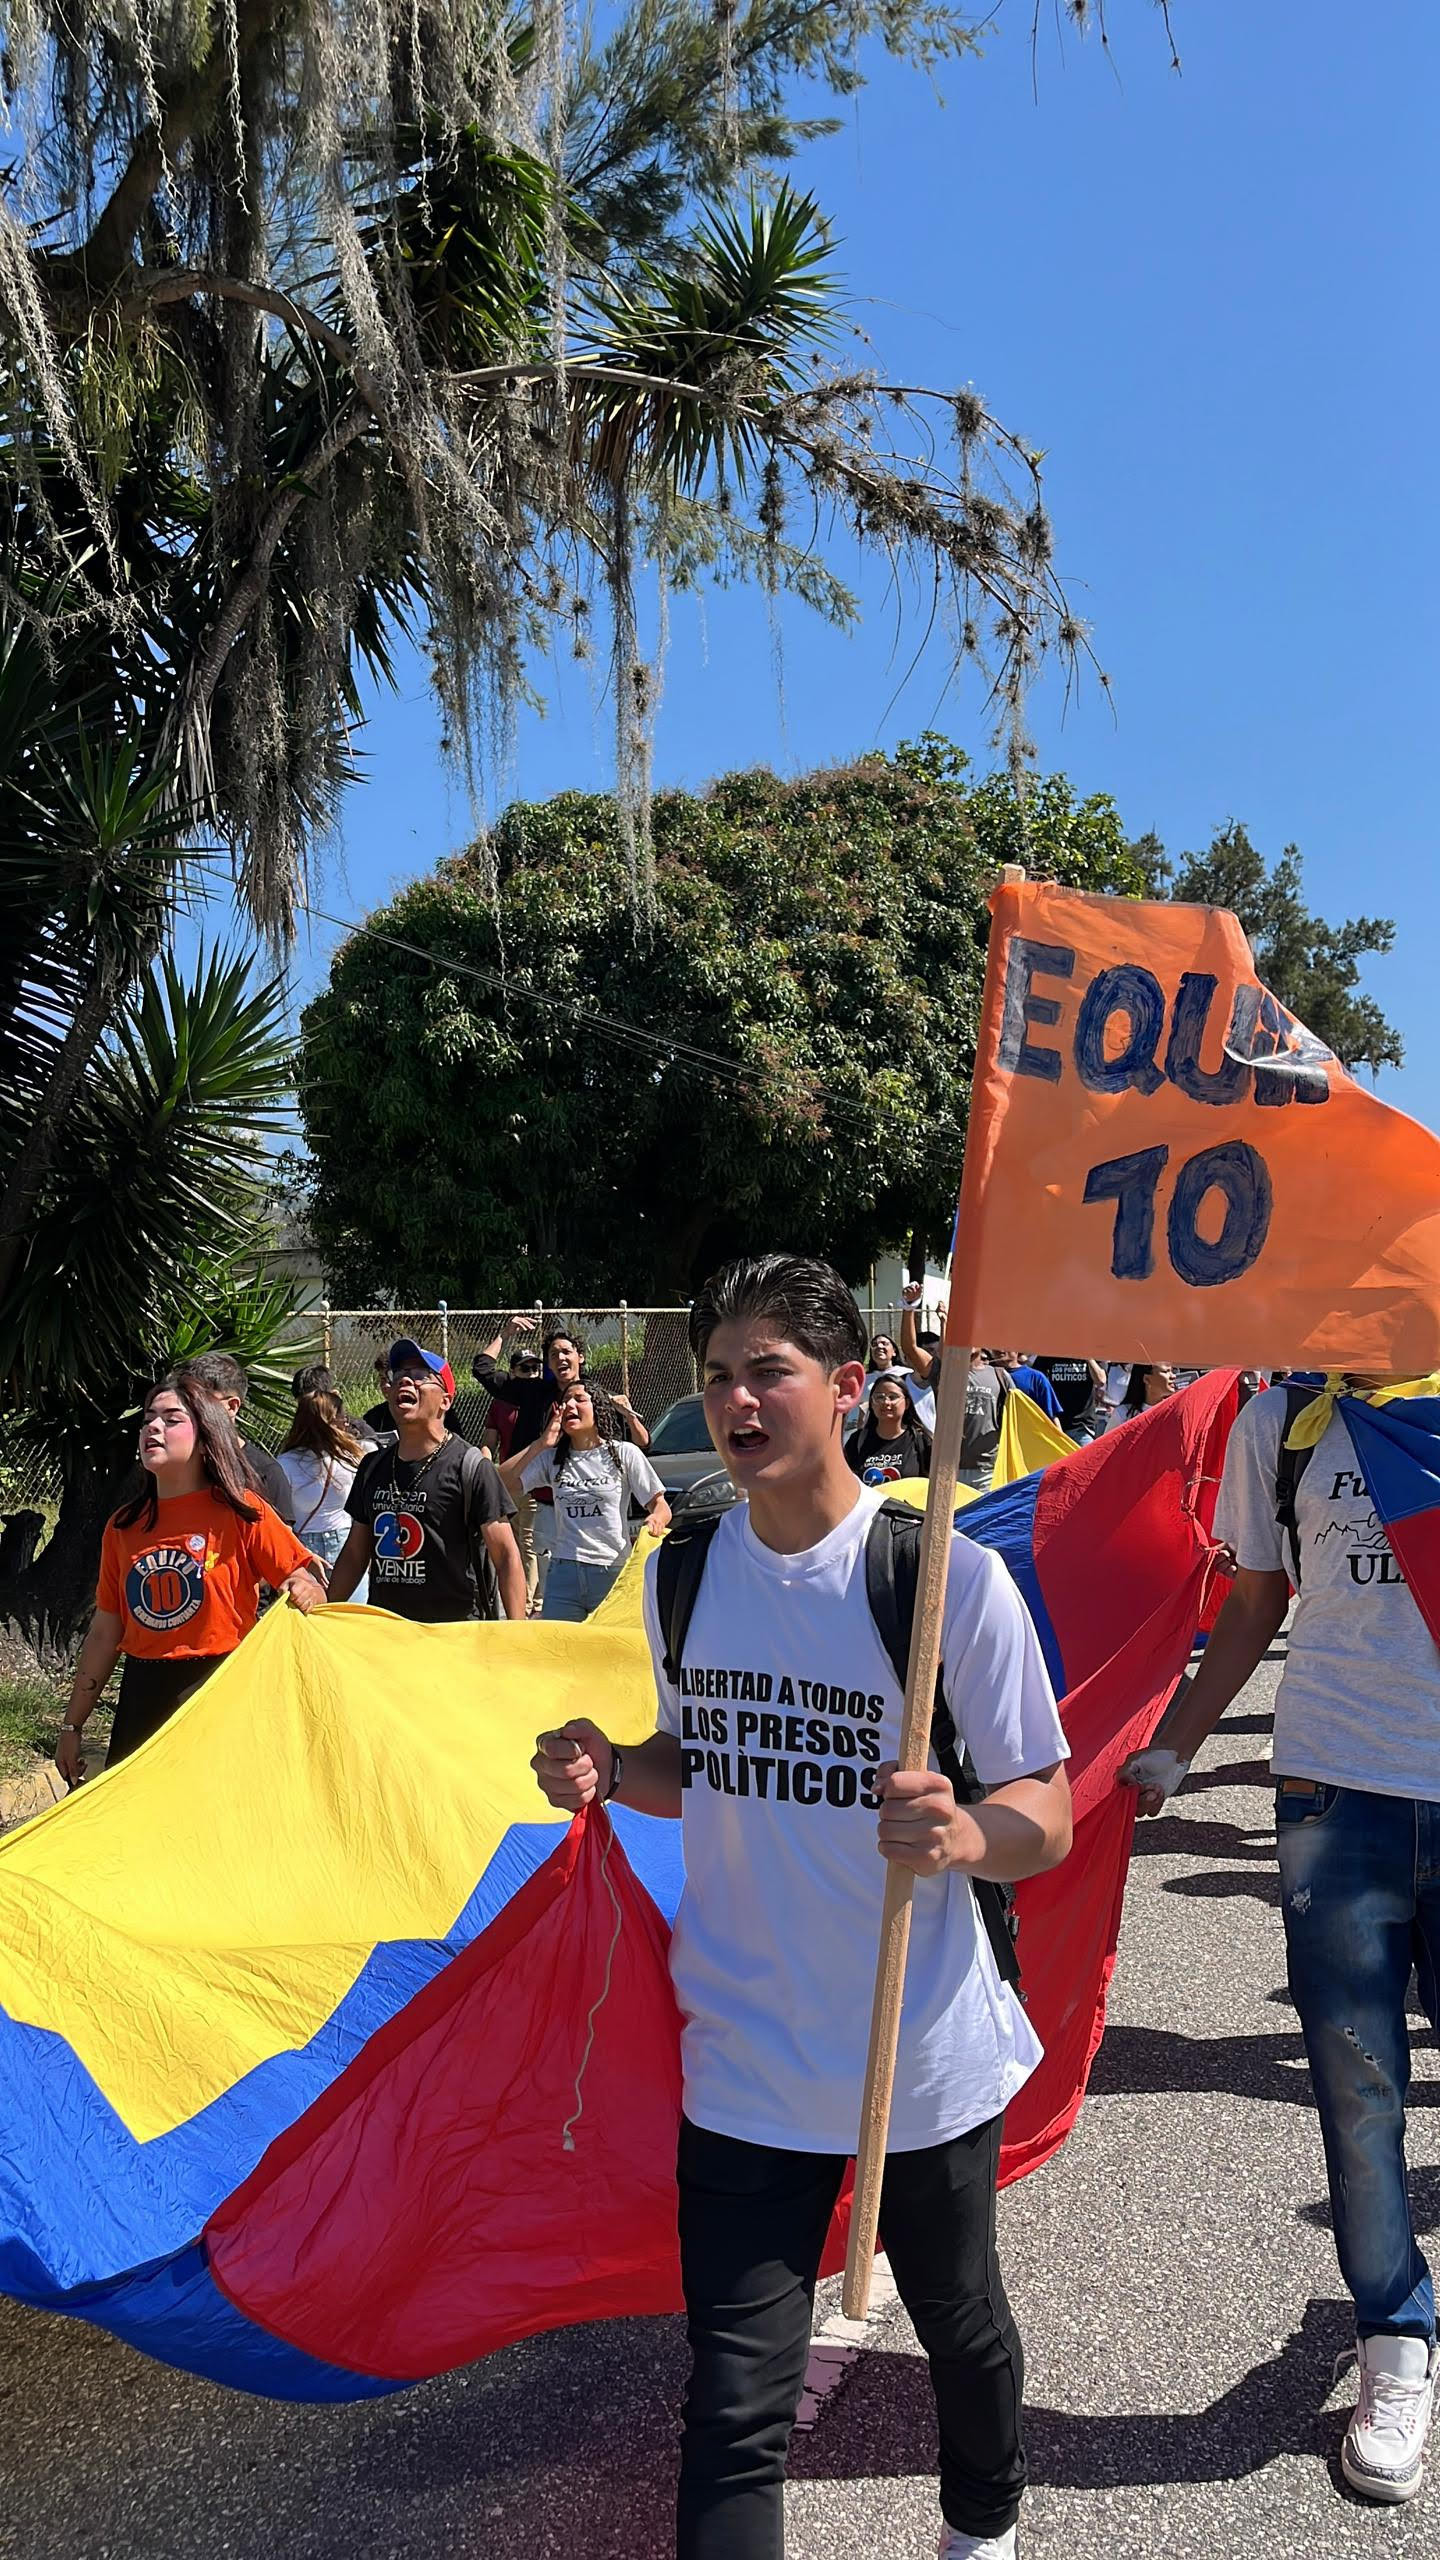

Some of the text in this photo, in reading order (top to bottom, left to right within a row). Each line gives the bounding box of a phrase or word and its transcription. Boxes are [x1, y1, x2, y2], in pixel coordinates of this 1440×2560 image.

[1082, 1139, 1274, 1287] 10
[566, 1504, 604, 1519] ULA
[374, 1511, 425, 1560] 20
[134, 1550, 196, 1577] EQUIPO
[375, 1559, 426, 1577] VEINTE
[1346, 1552, 1408, 1585] UL
[147, 1571, 183, 1613] 10
[680, 1667, 885, 1724] LIBERTAD A TODOS
[681, 1706, 881, 1762] LOS PRESOS
